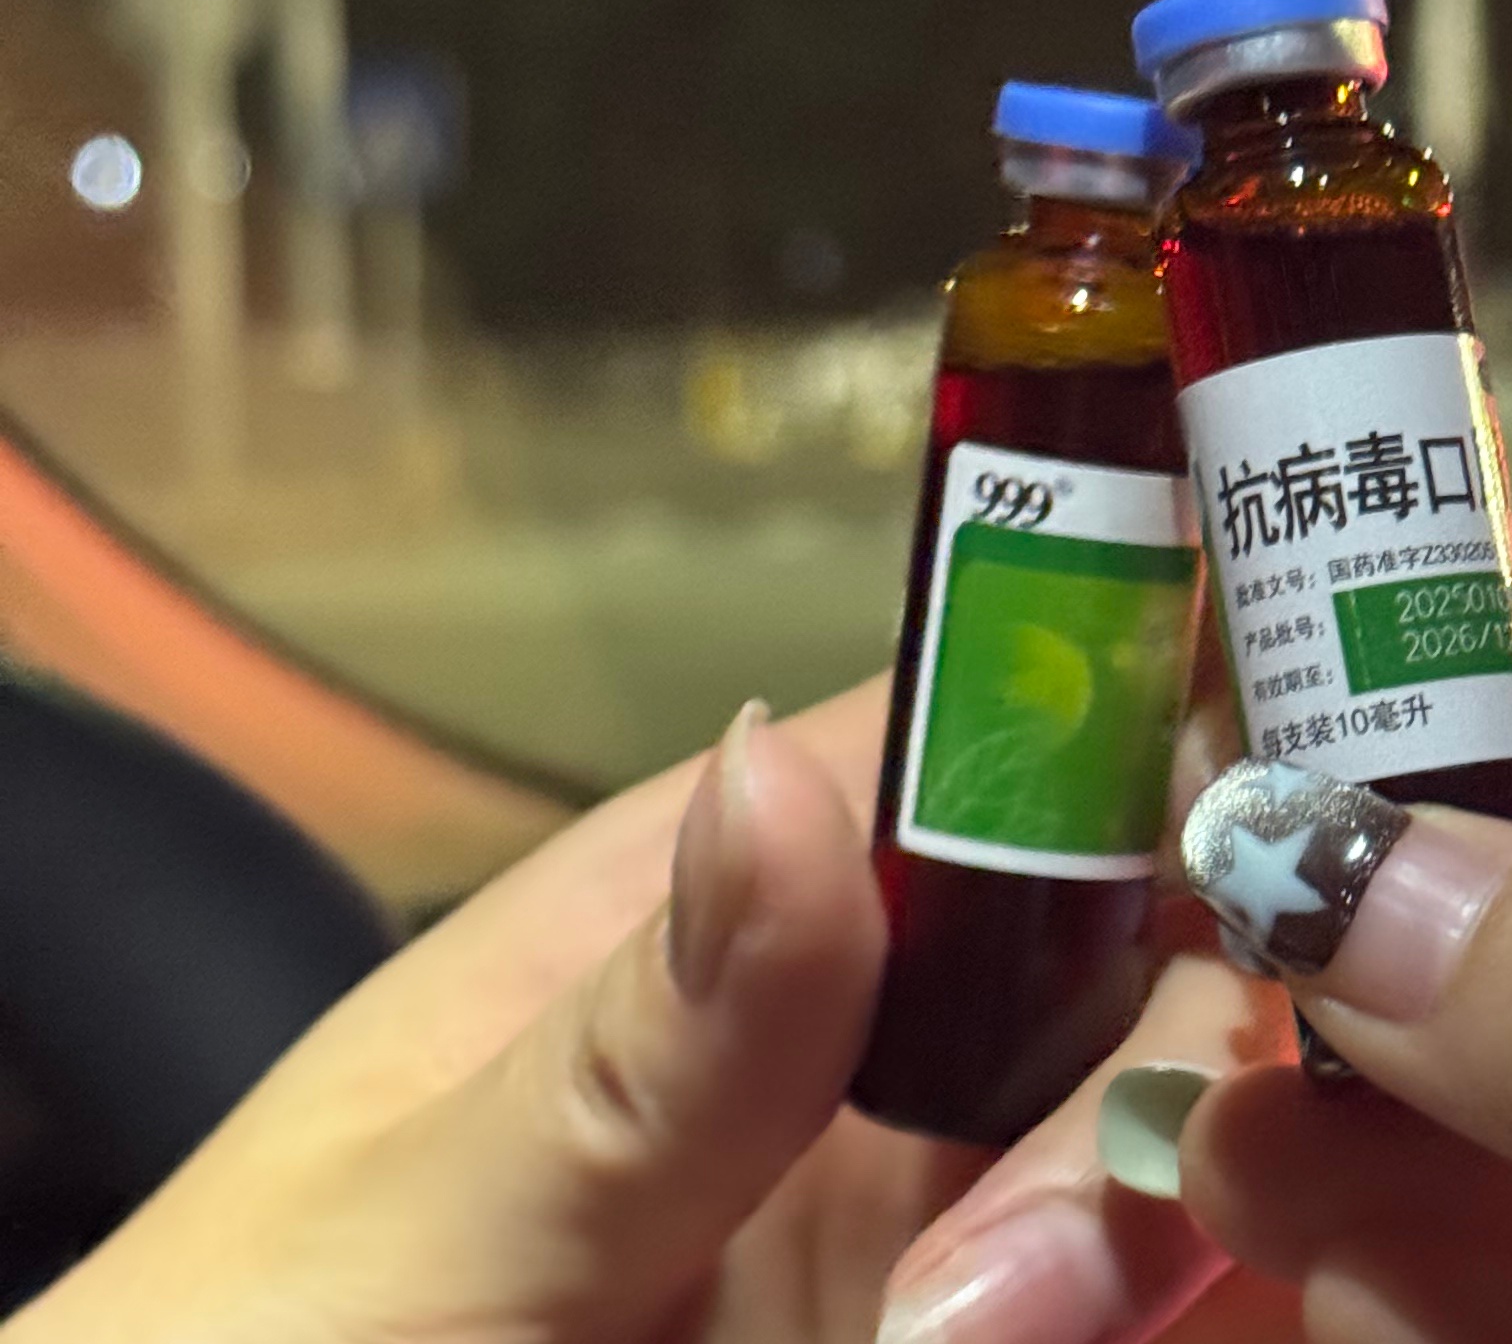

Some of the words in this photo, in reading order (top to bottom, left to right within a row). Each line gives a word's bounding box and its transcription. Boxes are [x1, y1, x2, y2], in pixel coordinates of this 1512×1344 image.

[975, 471, 1054, 530] 999
[1218, 431, 1488, 559] 抗病毒口
[1262, 692, 1433, 759] 每支装10毫升
